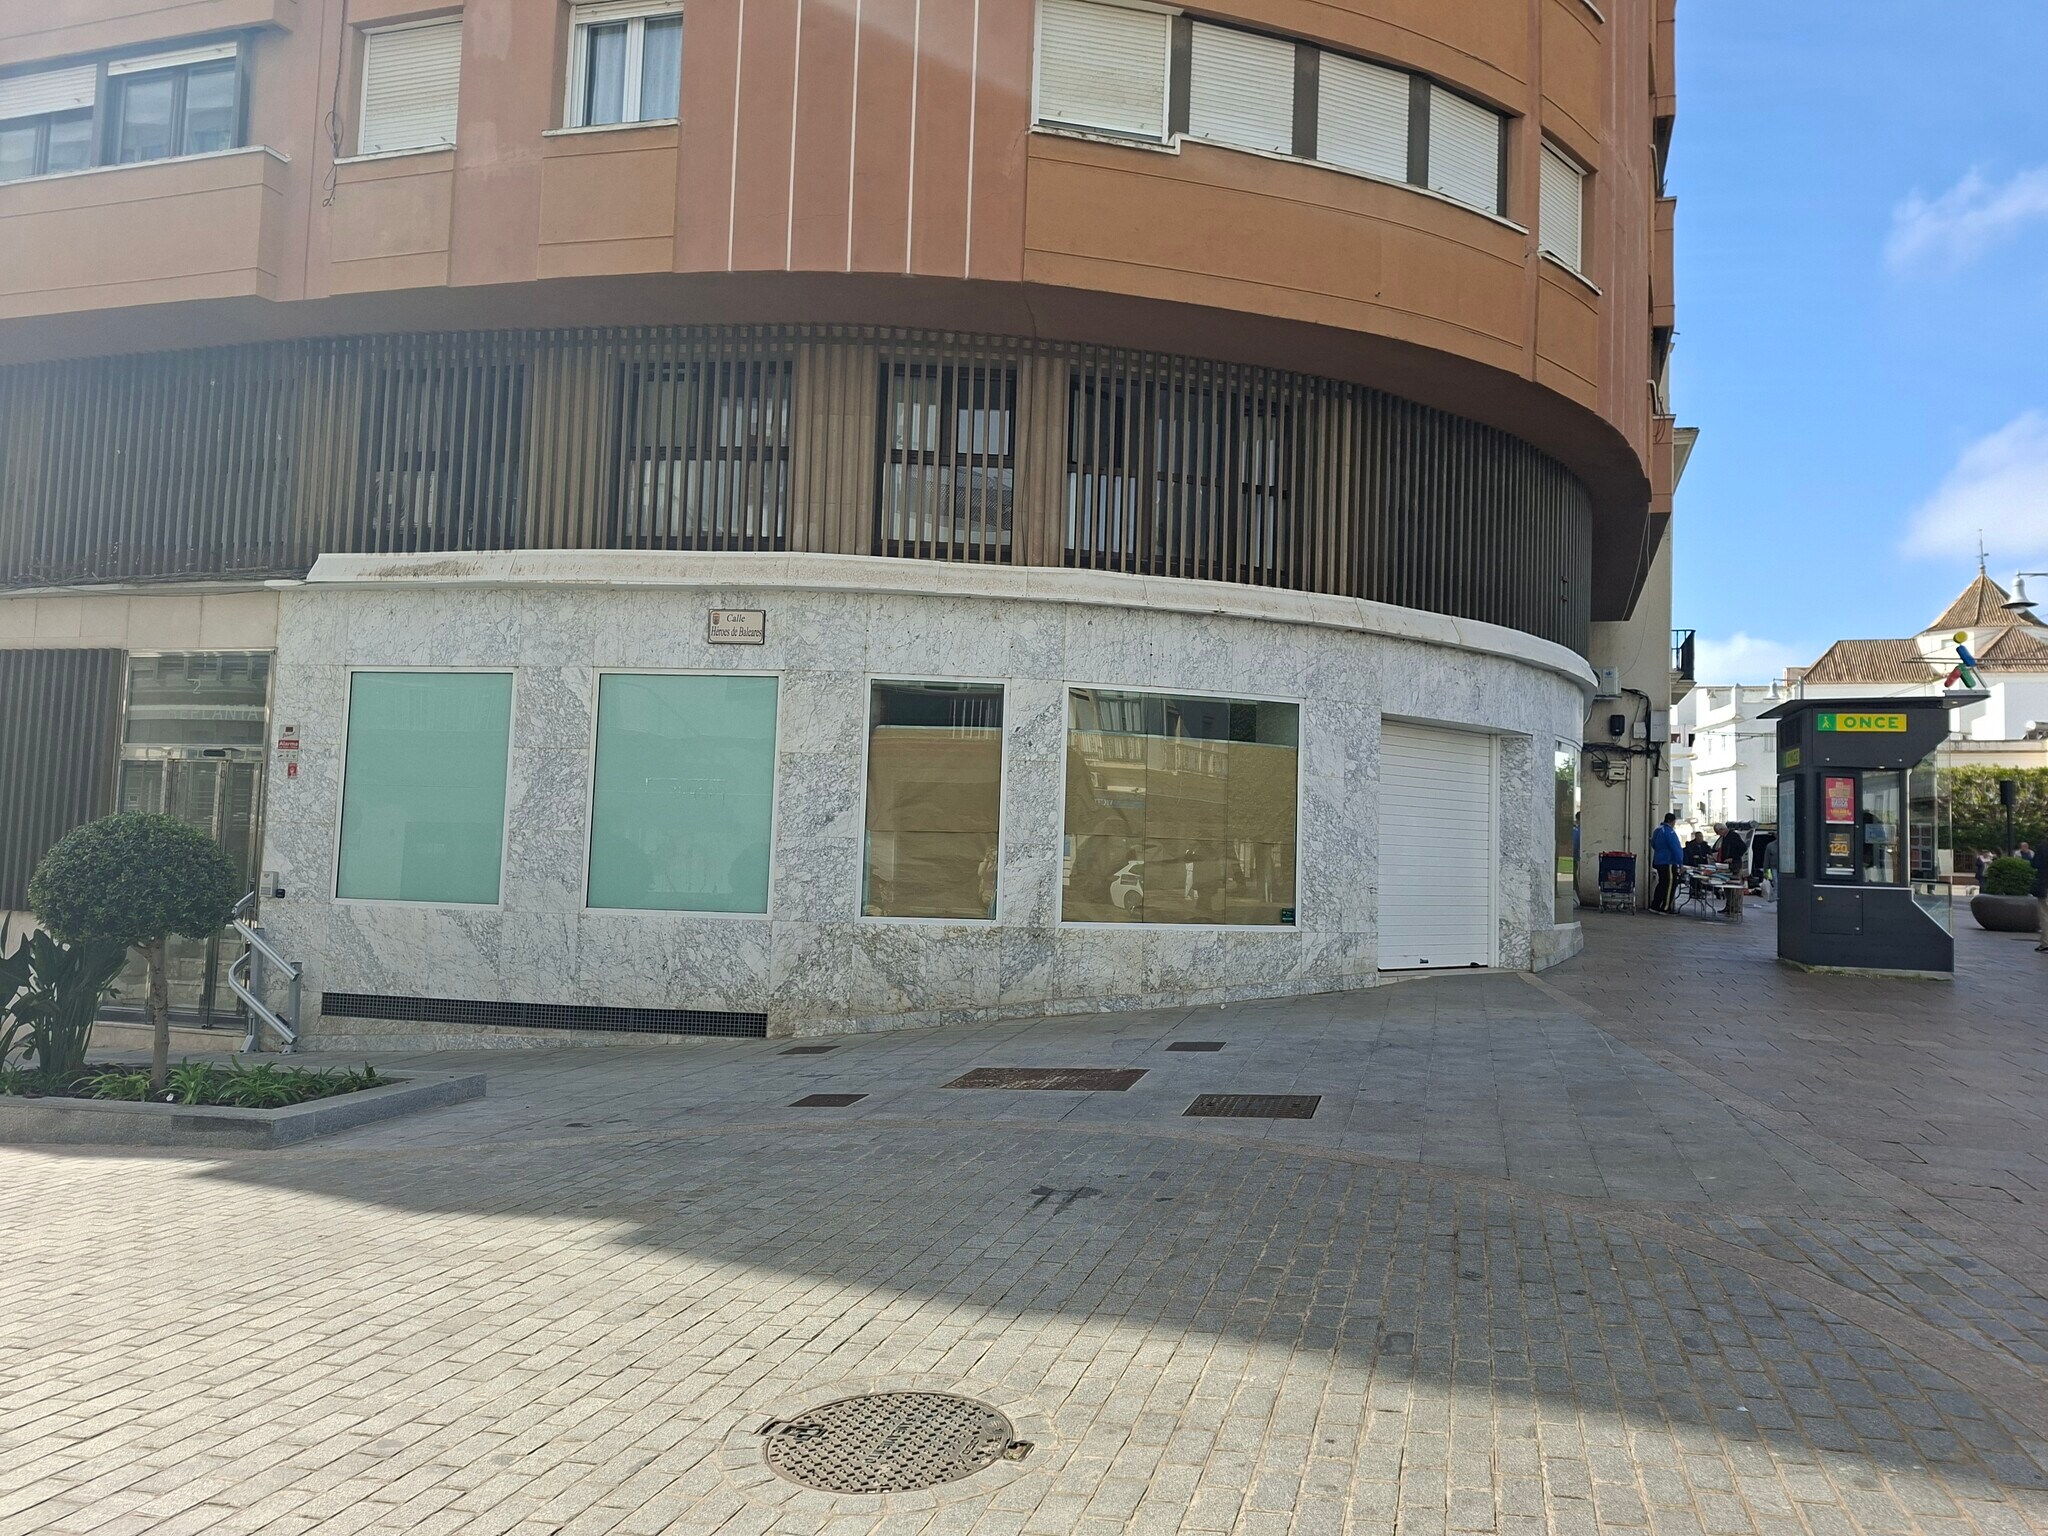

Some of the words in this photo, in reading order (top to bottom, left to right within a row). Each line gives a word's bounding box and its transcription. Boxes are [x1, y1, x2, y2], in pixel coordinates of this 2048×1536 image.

[726, 614, 746, 622] Calle
[731, 626, 738, 637] de
[739, 626, 762, 637] Baleares
[1843, 716, 1899, 729] ONCE
